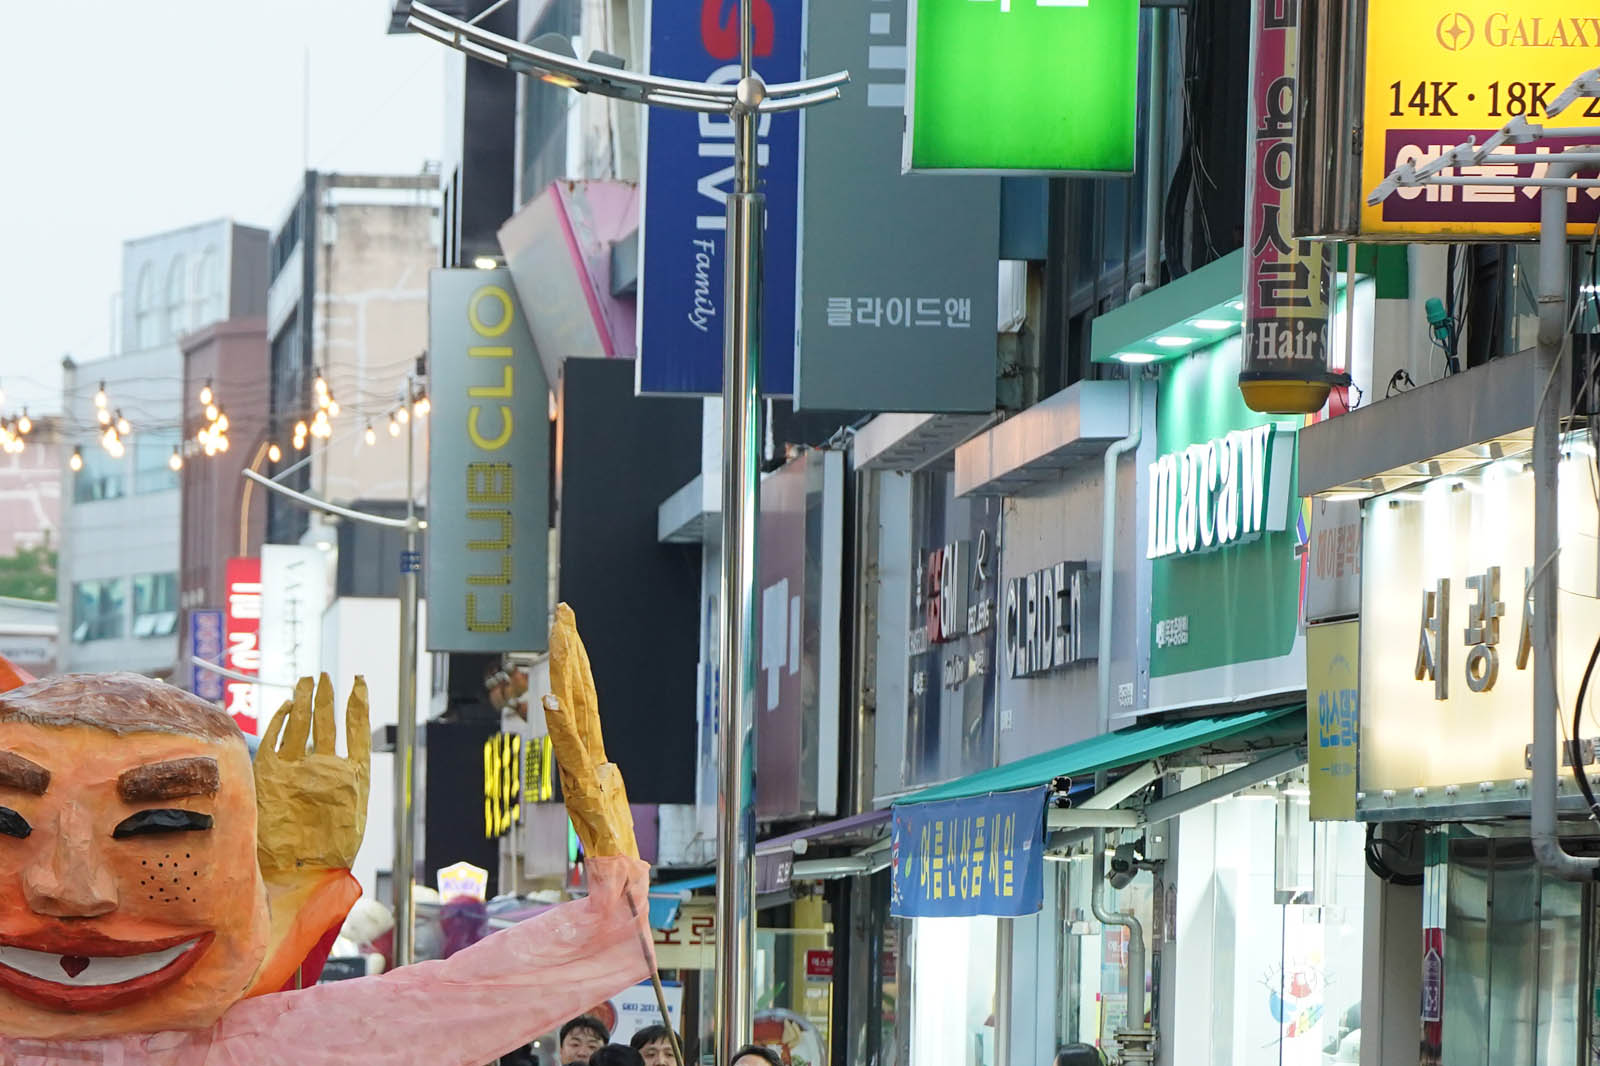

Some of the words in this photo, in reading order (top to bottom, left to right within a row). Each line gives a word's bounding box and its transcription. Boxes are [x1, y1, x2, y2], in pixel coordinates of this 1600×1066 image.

[1389, 80, 1459, 117] 14K
[1487, 81, 1557, 117] 18K
[688, 240, 716, 332] Family
[826, 297, 972, 329] 클라이드앤
[467, 284, 514, 451] CLIO
[1256, 320, 1318, 361] Hair
[1146, 423, 1271, 560] macaw
[466, 463, 513, 634] CLUB
